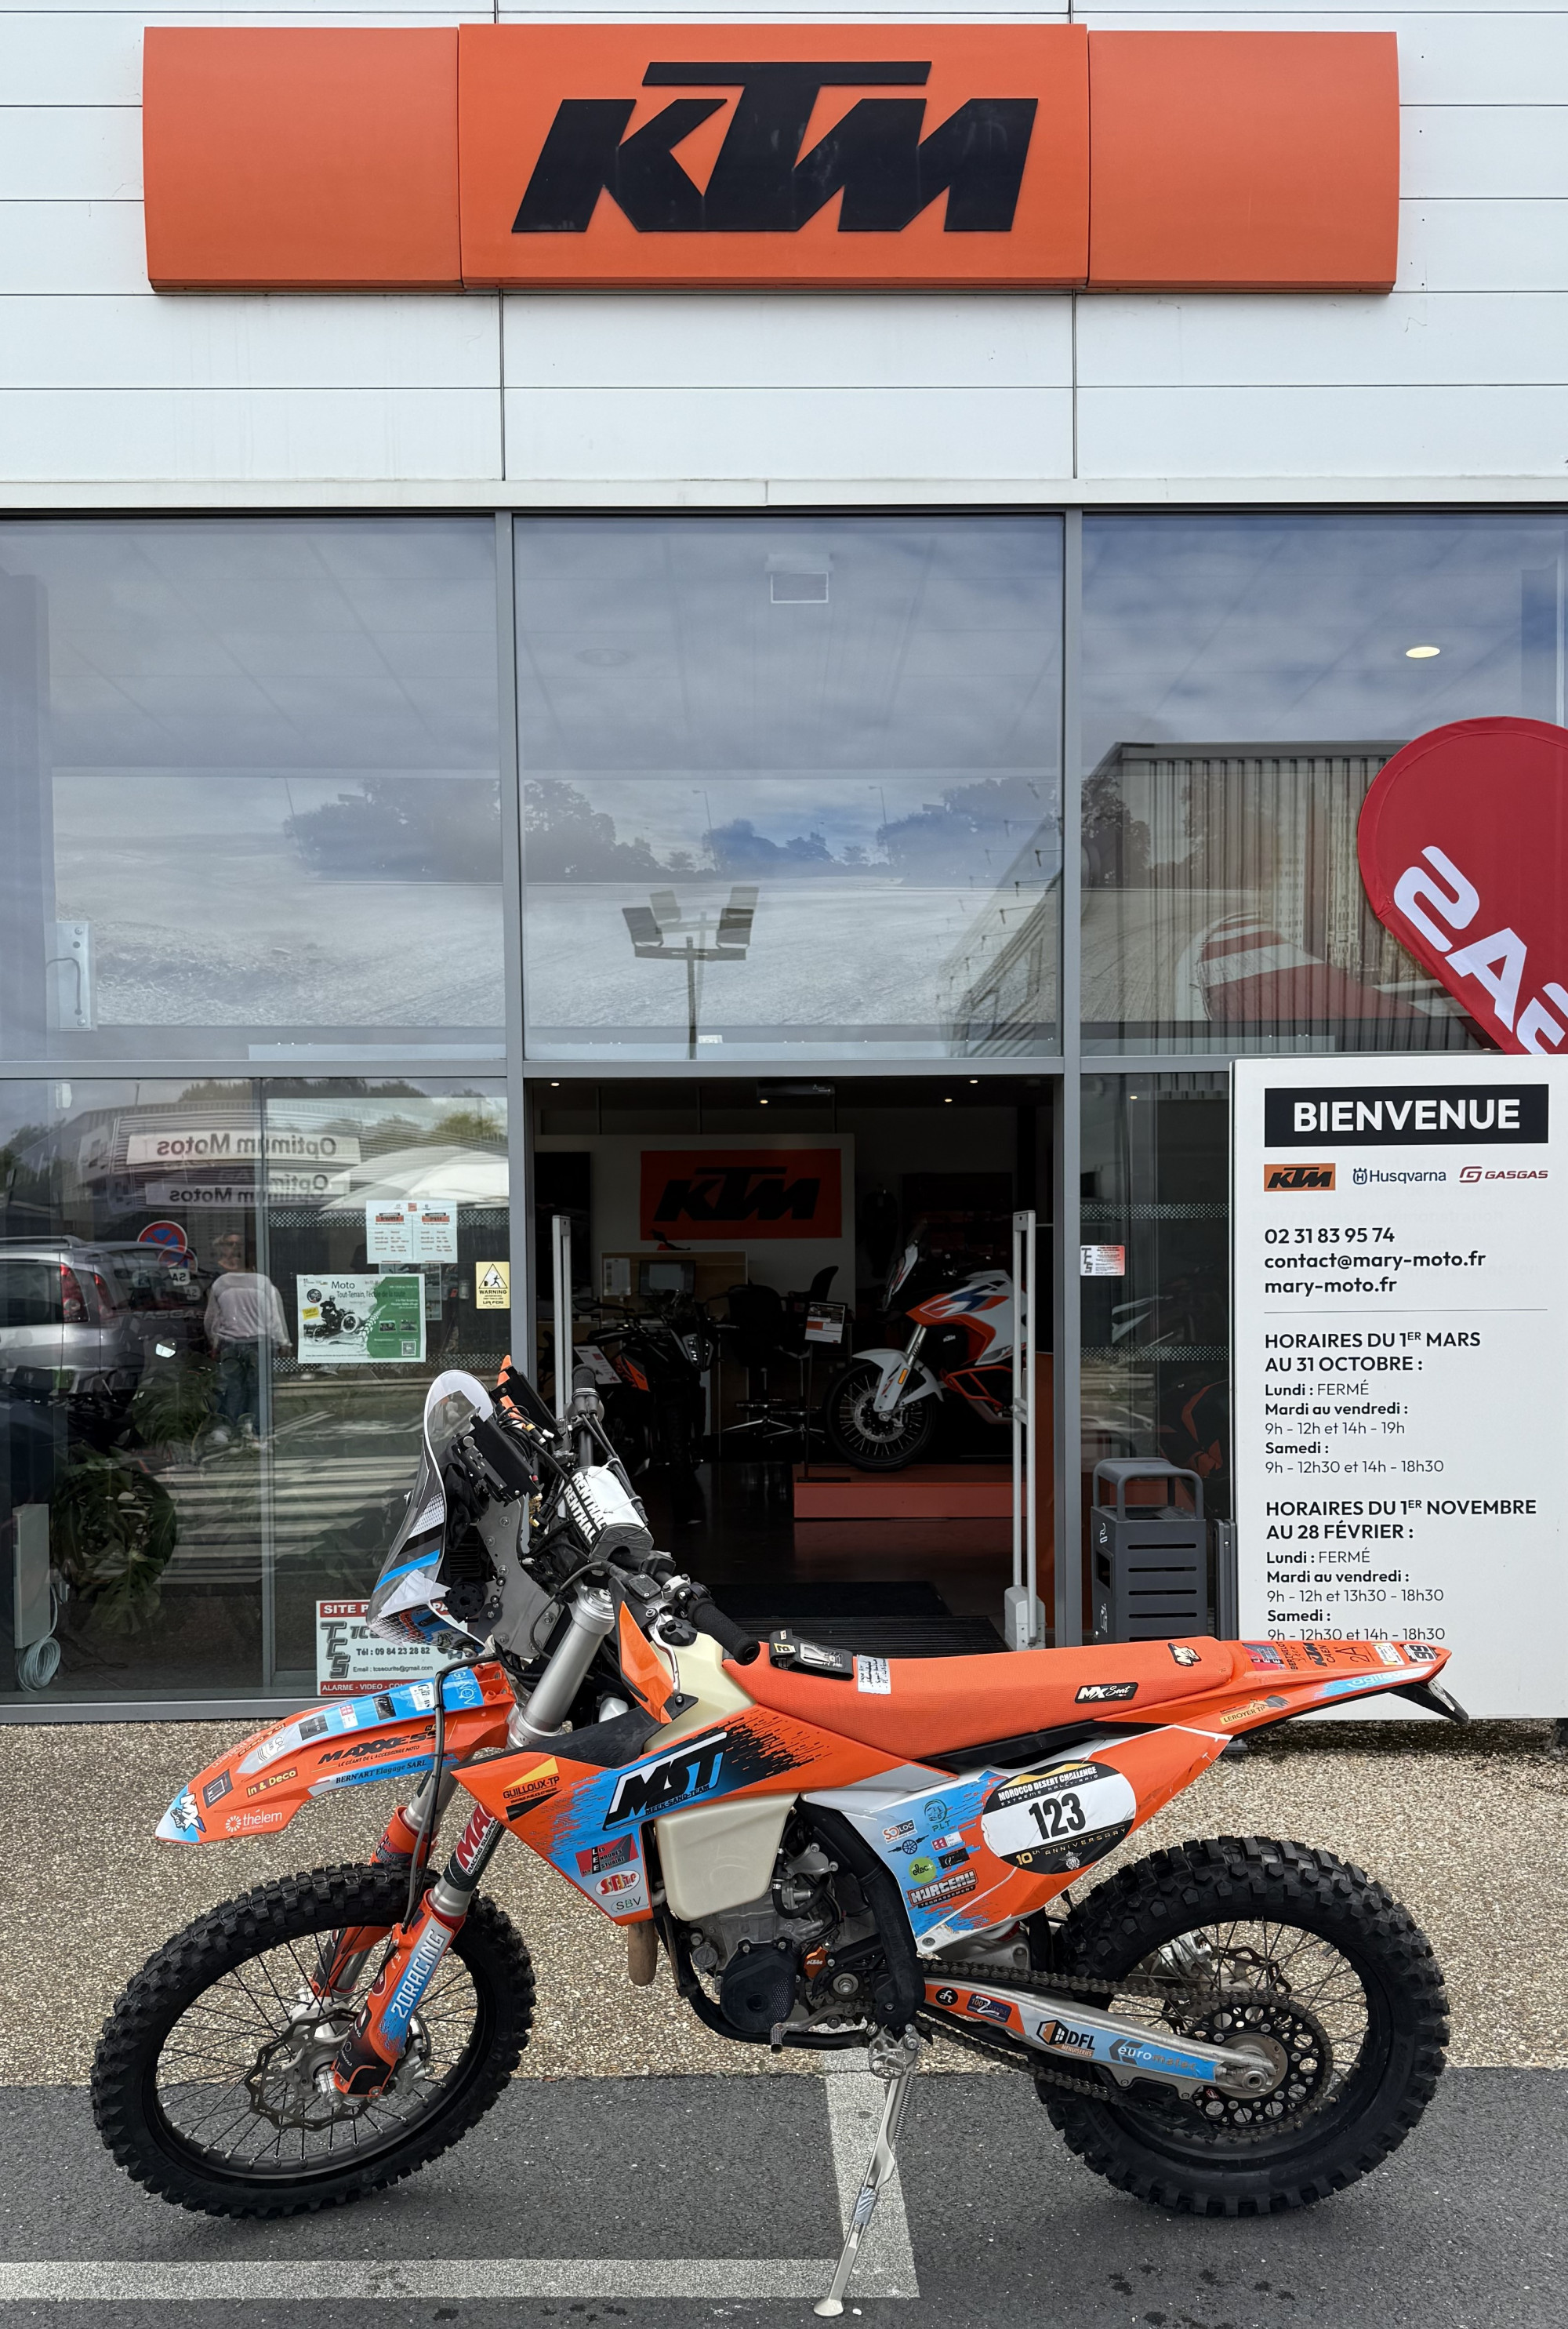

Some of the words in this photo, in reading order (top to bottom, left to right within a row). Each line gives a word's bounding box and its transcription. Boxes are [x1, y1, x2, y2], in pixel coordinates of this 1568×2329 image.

[511, 60, 1038, 233] KTM
[1294, 1099, 1520, 1132] BIENVENUE
[1267, 1167, 1332, 1189] KTM
[1369, 1168, 1446, 1185] Husqvarna
[1484, 1169, 1548, 1180] GASGAS
[654, 1167, 820, 1222] KTM
[1265, 1228, 1290, 1244] 02
[1294, 1228, 1312, 1244] 31
[1317, 1227, 1340, 1244] 83
[1345, 1227, 1368, 1243] 95
[1371, 1226, 1396, 1243] 74
[1264, 1250, 1486, 1271] contact@mary-moto.fr
[331, 1281, 355, 1289] Moto
[1265, 1276, 1398, 1297] mary-moto.fr
[336, 1290, 366, 1299] Tout-Terrain,
[1265, 1332, 1363, 1349] HORAIRES
[1367, 1332, 1396, 1348] DU
[1426, 1332, 1481, 1347] MARS
[1265, 1357, 1292, 1372] AU
[1296, 1357, 1314, 1372] 31
[1319, 1356, 1414, 1372] OCTOBRE
[1265, 1383, 1305, 1397] Lundi
[1317, 1379, 1370, 1396] FERMÉ
[1265, 1402, 1309, 1415] Mardi
[1312, 1406, 1330, 1415] au
[1334, 1401, 1400, 1415] vendredi
[1265, 1422, 1283, 1435] 9h
[1297, 1422, 1321, 1435] 12h
[1324, 1422, 1339, 1435] et
[1341, 1421, 1367, 1434] 14h
[1381, 1421, 1405, 1434] 19h
[1265, 1441, 1321, 1455] Samedi
[1265, 1461, 1283, 1473] 9h
[1297, 1460, 1341, 1473] 12h30
[1344, 1461, 1359, 1473] et
[1362, 1459, 1386, 1473] 14h
[1400, 1459, 1444, 1473] 18h30
[571, 1471, 608, 1531] RENTHAL
[1266, 1500, 1364, 1517] HORAIRES
[1368, 1500, 1396, 1516] DU
[1427, 1499, 1537, 1515] NOVEMBRE
[564, 1484, 597, 1545] RENTHAL
[1265, 1524, 1293, 1540] AU
[1298, 1524, 1319, 1539] 28
[1324, 1520, 1404, 1539] FÉVRIER
[1266, 1550, 1307, 1564] Lundi
[1319, 1546, 1370, 1564] FERMÉ
[1267, 1570, 1311, 1583] Mardi
[1313, 1573, 1332, 1582] au
[1335, 1569, 1402, 1582] vendredi
[1266, 1590, 1285, 1603] 9h
[1299, 1589, 1323, 1602] 12h
[1326, 1590, 1341, 1602] et
[1343, 1589, 1387, 1602] 13h30
[1400, 1589, 1444, 1602] 18h30
[324, 1604, 357, 1614] SITE
[1267, 1608, 1323, 1622] Samedi
[1267, 1628, 1286, 1640] 9h
[1299, 1628, 1342, 1640] 12h30
[1346, 1628, 1361, 1640] et
[1363, 1627, 1388, 1640] 14h
[1402, 1627, 1446, 1640] 18h30
[356, 1648, 368, 1656] Tél
[1302, 1643, 1327, 1667] KTM
[1320, 1644, 1336, 1663] CAEN
[1078, 1686, 1106, 1700] MX
[1223, 1708, 1256, 1724] LEROYER
[1256, 1705, 1266, 1714] TP
[317, 1731, 437, 1765] MAXXESS
[405, 1745, 420, 1753] MOTO
[376, 1765, 405, 1777] Elagage
[406, 1760, 426, 1771] SARL
[247, 1786, 257, 1797] In
[259, 1782, 267, 1790] &
[268, 1770, 297, 1785] Deco
[503, 1775, 561, 1800] GUILLOUX-TP
[608, 1746, 724, 1822] MST
[997, 1783, 1033, 1802] MOROCCO
[1033, 1776, 1059, 1791] DESERT
[1058, 1766, 1098, 1783] CHALLENGE
[1001, 1790, 1042, 1806] EXTREME
[242, 1808, 283, 1827] thélem
[1029, 1793, 1086, 1840] 123
[467, 1848, 483, 1873] RACING
[481, 1819, 499, 1848] SUSPEN
[1044, 1828, 1127, 1855] ANNIVERSARY
[615, 1896, 641, 1910] SBV
[1066, 2031, 1095, 2051] DFL
[1061, 2044, 1093, 2058] MENUISERIES
